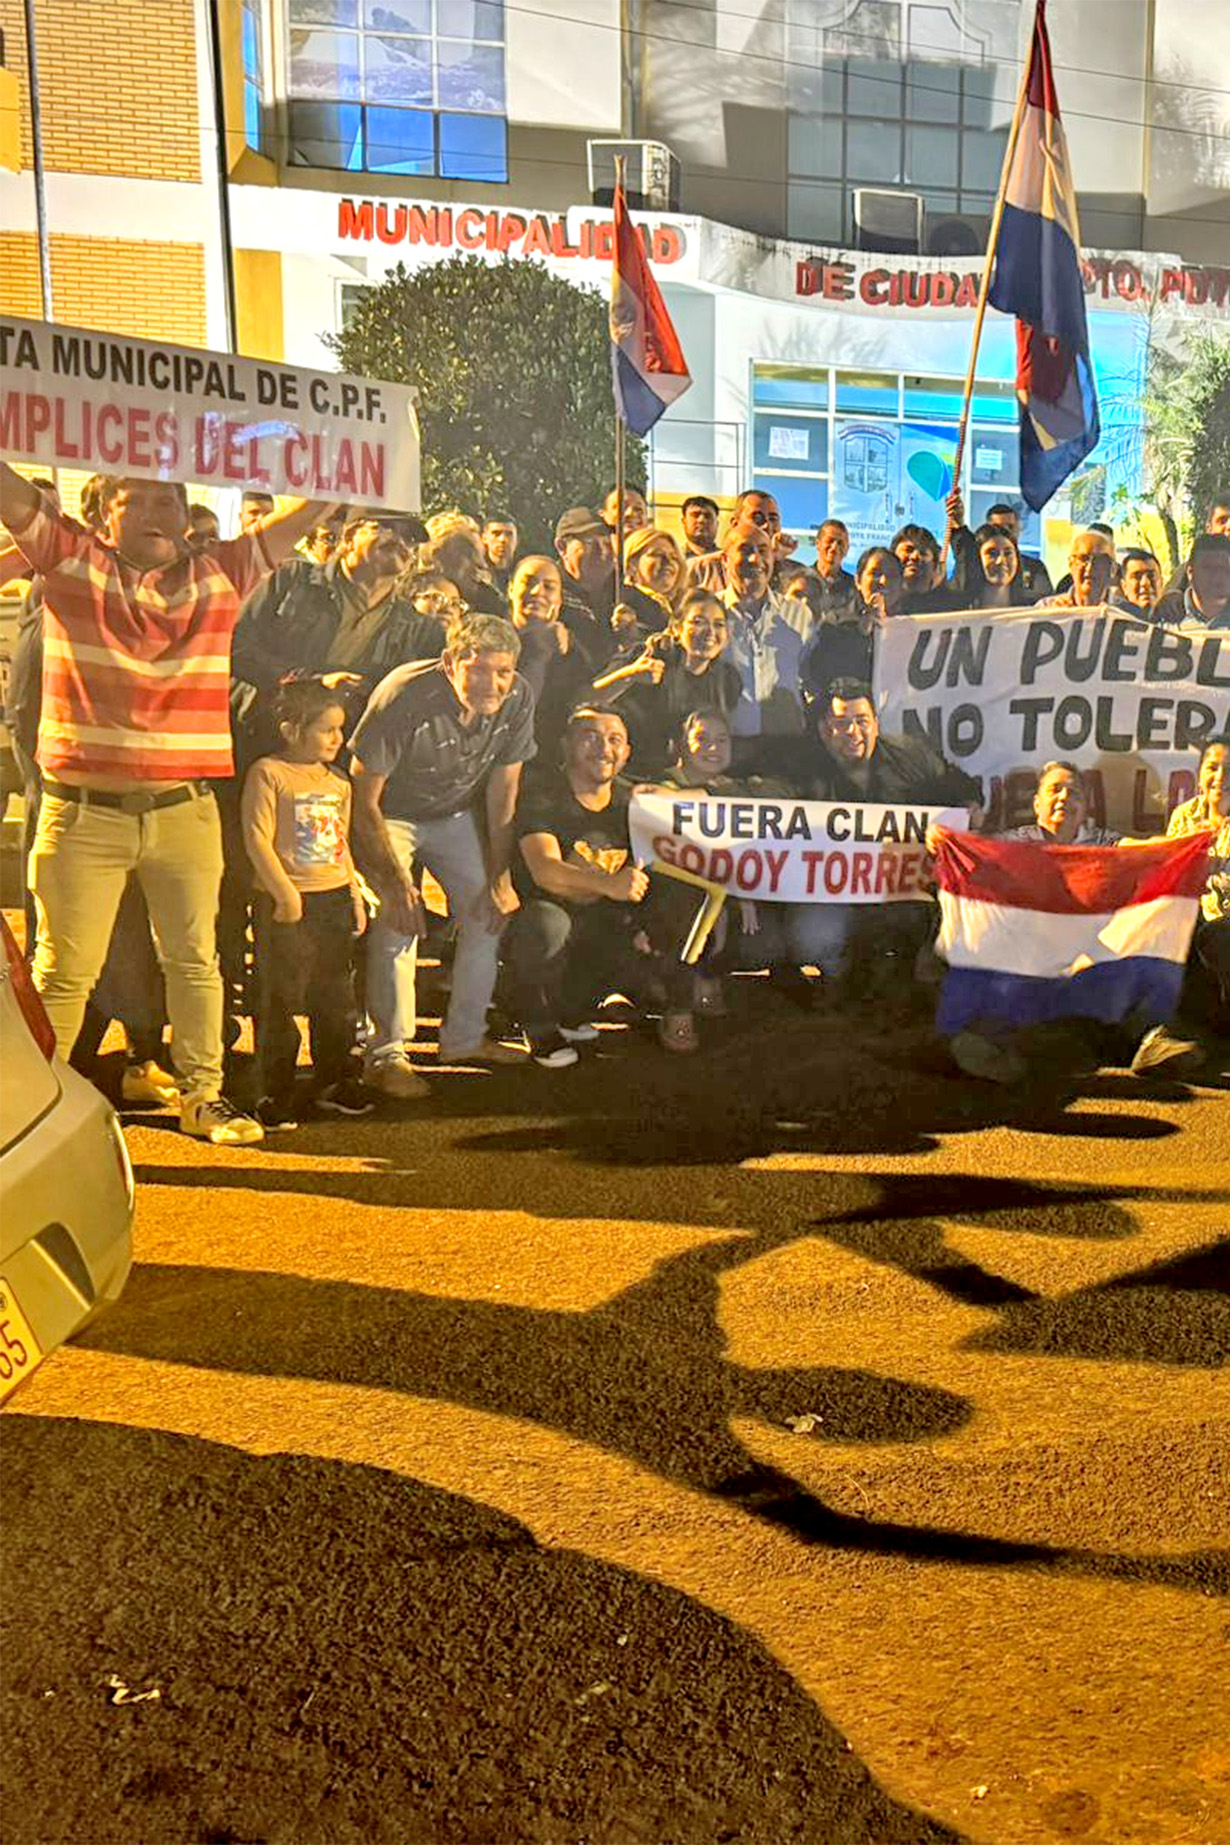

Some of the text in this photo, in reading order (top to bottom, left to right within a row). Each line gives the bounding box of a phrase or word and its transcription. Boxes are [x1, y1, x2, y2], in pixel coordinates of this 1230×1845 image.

[338, 199, 684, 264] MUNICIPALIDD
[796, 257, 856, 301] DE
[860, 268, 986, 308] CIUDA
[53, 335, 246, 401] MUNICIPAL
[257, 369, 299, 409] DE
[309, 378, 387, 423] C.P.F.
[195, 415, 270, 483] DEL
[284, 428, 385, 498] CLAN
[908, 625, 993, 690] UN
[902, 702, 984, 757] NO
[673, 802, 930, 843] FUERA CLAN
[652, 835, 935, 895] GODOY TORRES
